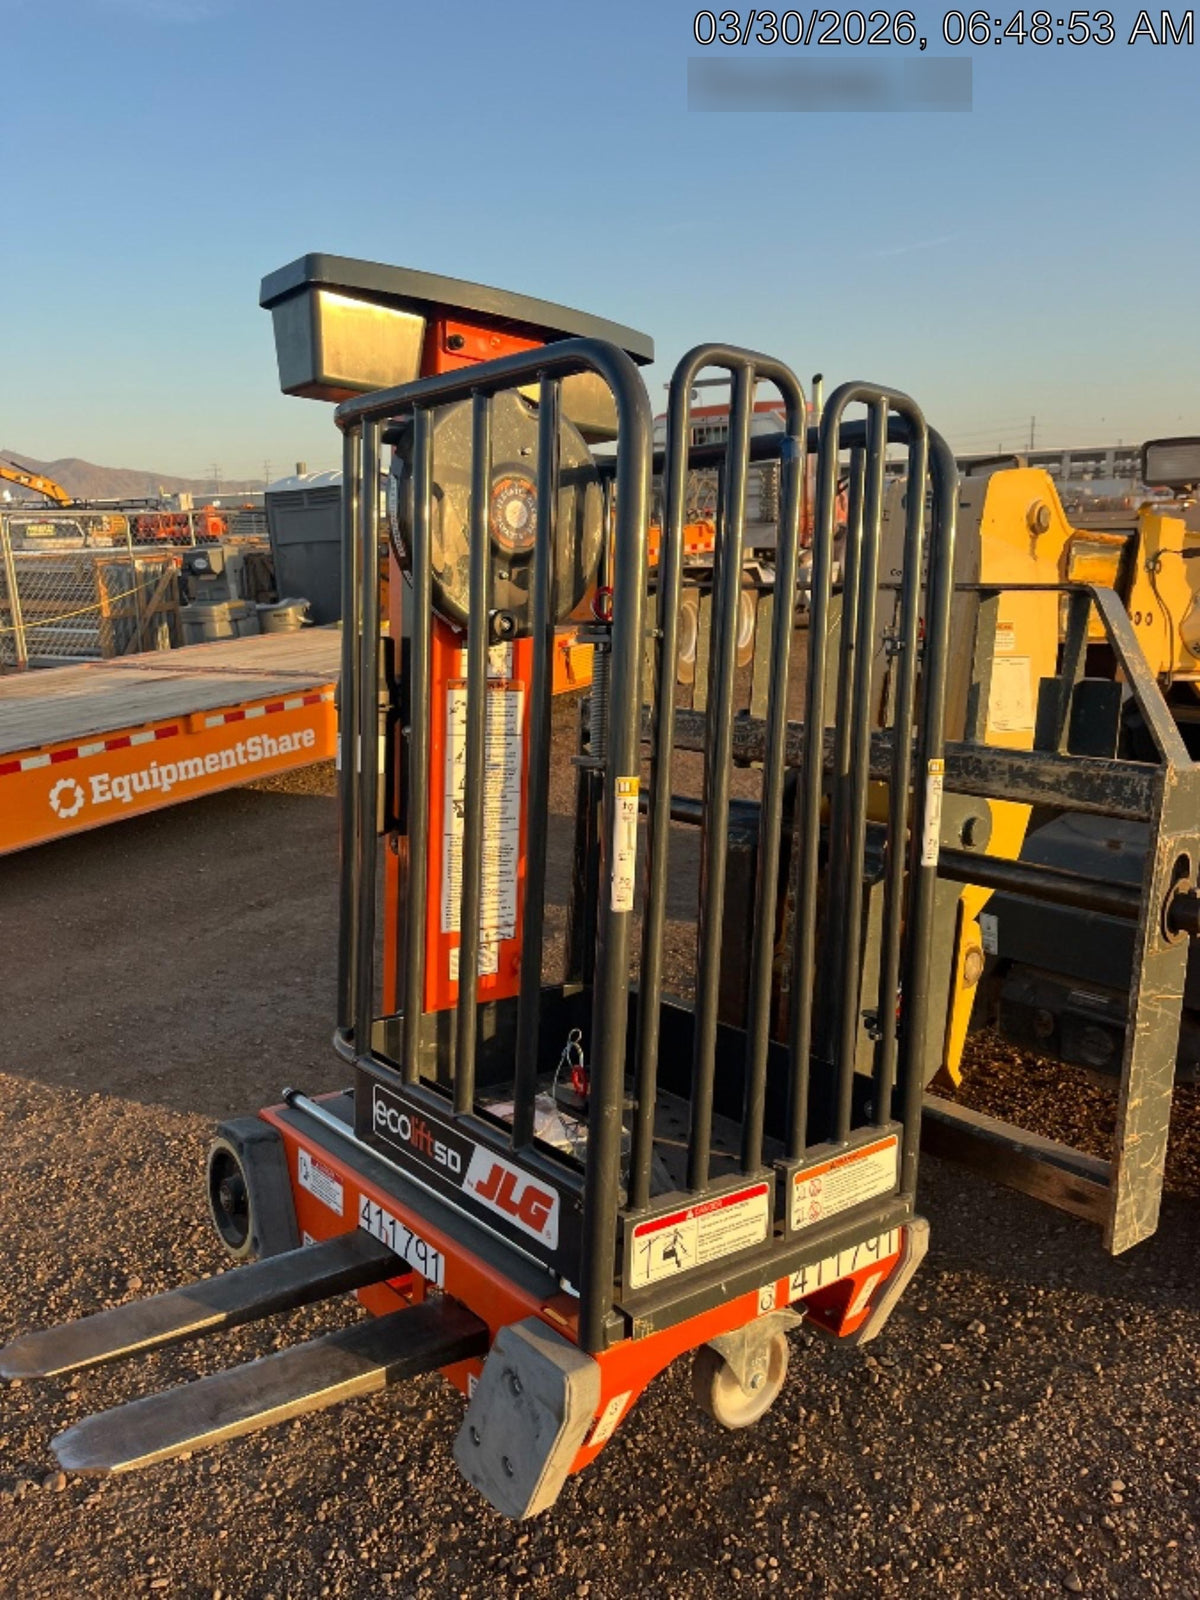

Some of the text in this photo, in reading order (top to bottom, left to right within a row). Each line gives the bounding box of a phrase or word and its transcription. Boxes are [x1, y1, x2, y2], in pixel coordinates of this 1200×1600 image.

[89, 728, 316, 804] EquipmentShare
[474, 1162, 555, 1234] JLG
[361, 1199, 439, 1284] 411791
